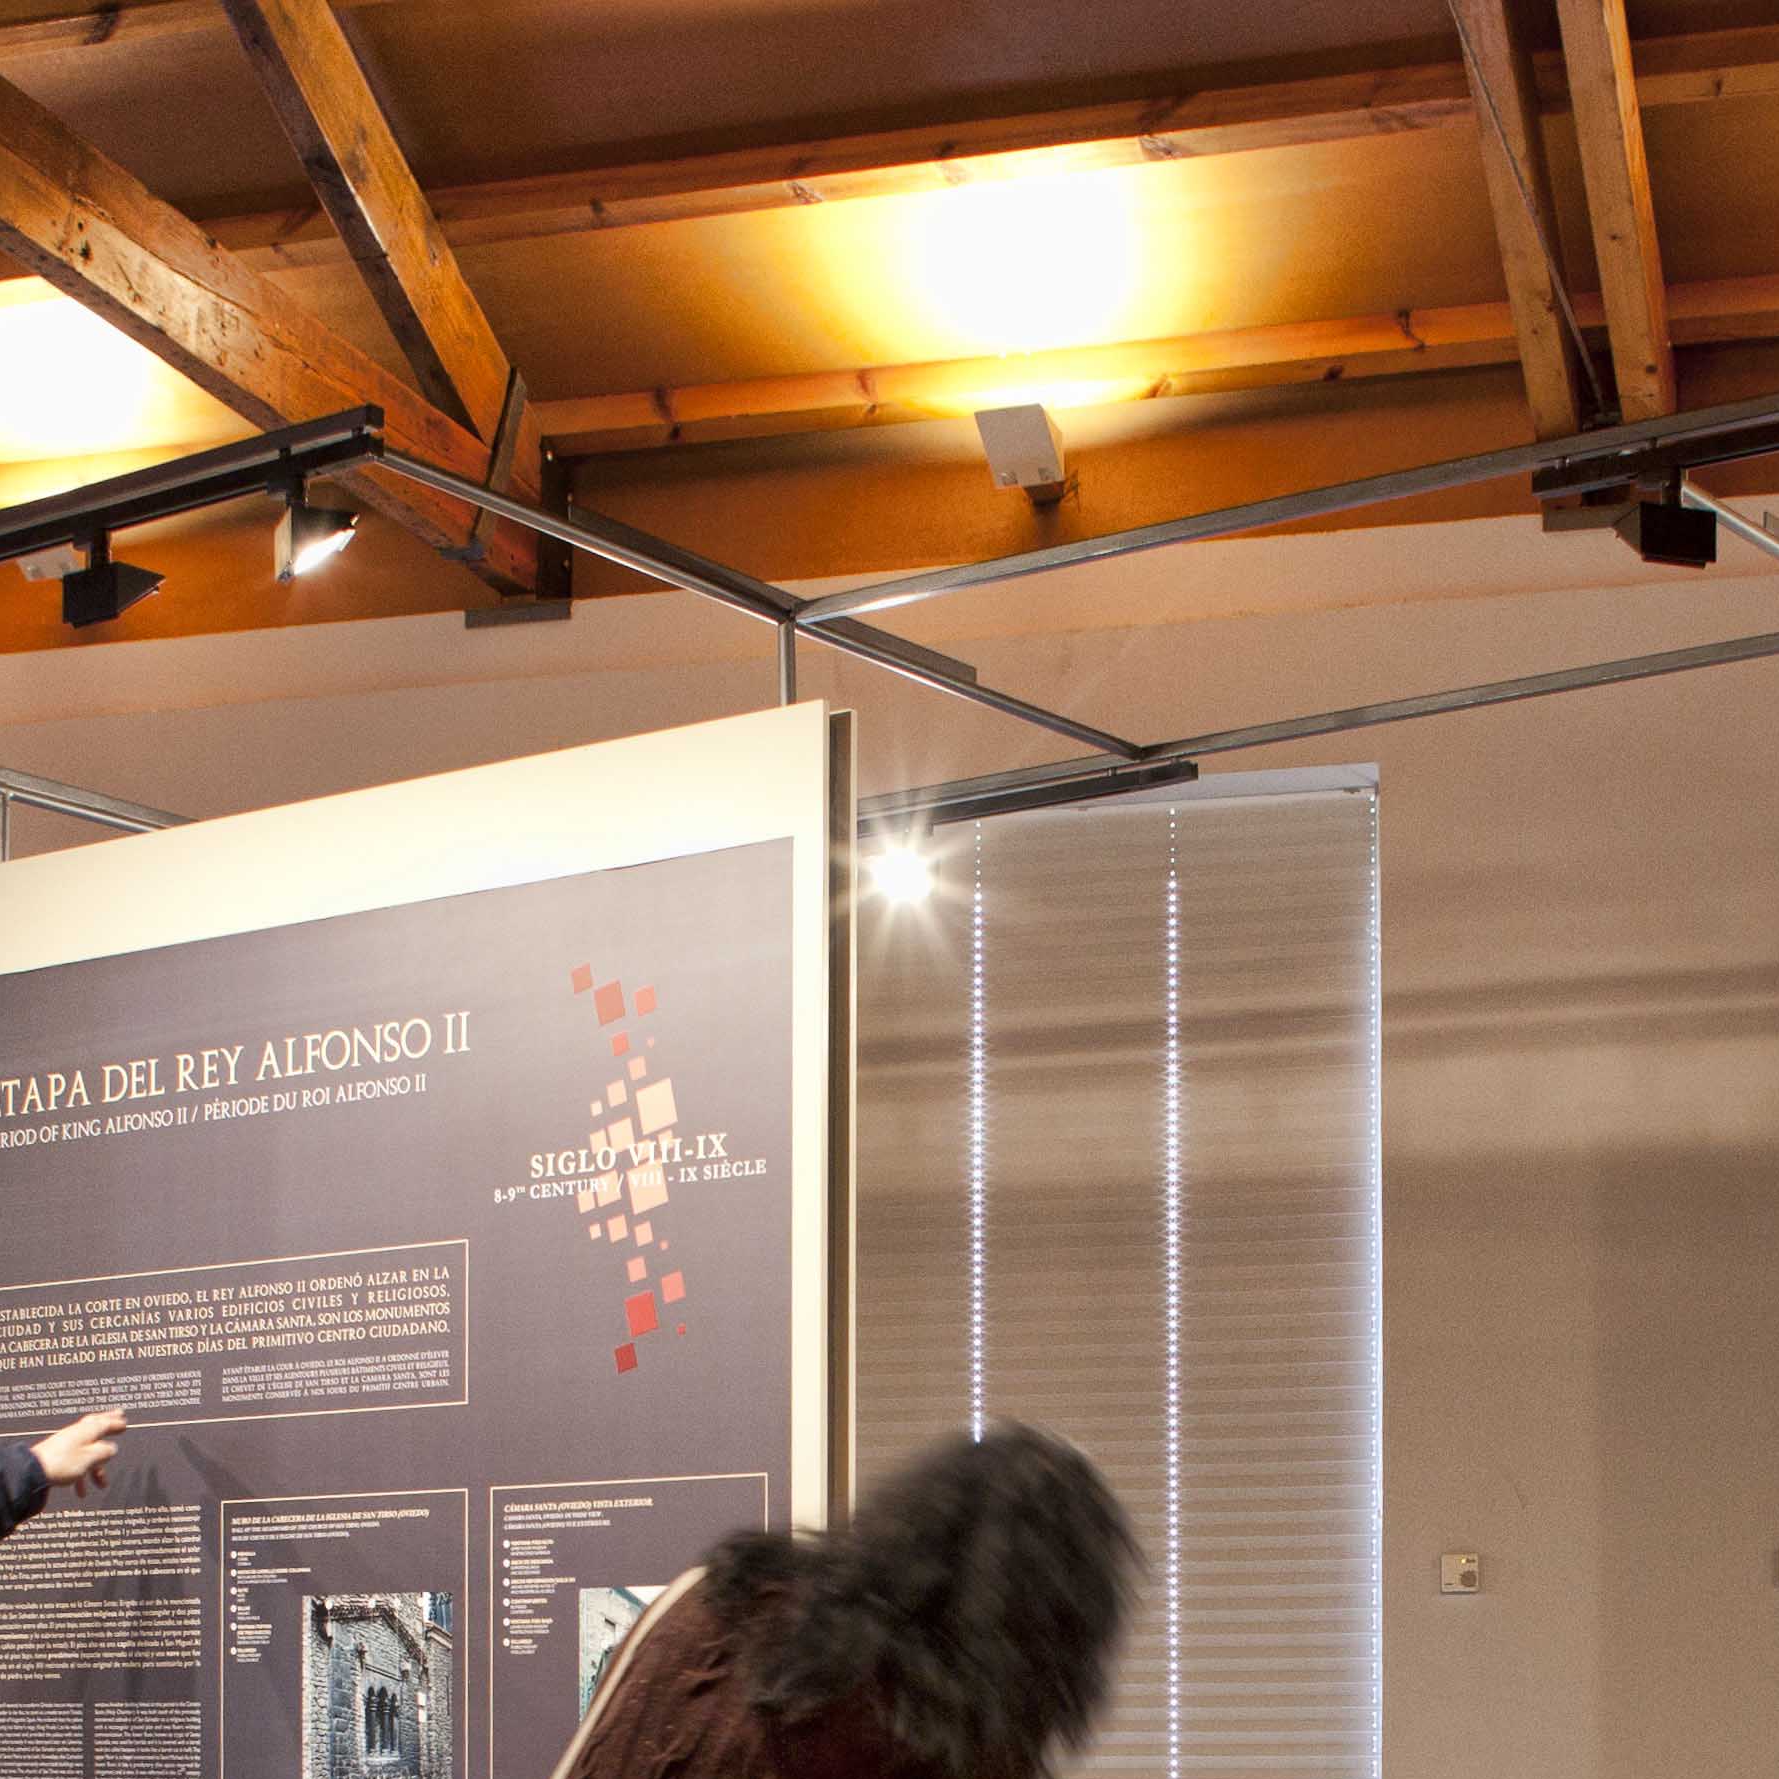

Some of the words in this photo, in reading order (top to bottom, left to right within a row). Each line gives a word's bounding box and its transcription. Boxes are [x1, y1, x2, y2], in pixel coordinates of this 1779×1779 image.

[103, 1061, 165, 1102] DEL
[176, 1047, 244, 1092] REY
[257, 1017, 432, 1081] ALFONSO
[443, 1011, 471, 1053] II
[40, 1126, 58, 1142] OF
[63, 1119, 100, 1140] KING
[106, 1110, 173, 1134] ALFONSO
[273, 1091, 297, 1112] DU
[302, 1087, 330, 1108] ROI
[335, 1078, 411, 1104] ALFONSO
[415, 1072, 430, 1092] II
[530, 1146, 616, 1178] SIGLO
[627, 1133, 728, 1167] VIII-IX
[530, 1177, 610, 1199] CENTURY
[630, 1169, 664, 1188] VIII
[680, 1166, 698, 1183] IX
[703, 1158, 767, 1181] SIÈCLE
[49, 1322, 54, 1332] Y
[63, 1319, 83, 1331] SUS
[91, 1311, 160, 1329] CERCANÍAS
[169, 1306, 214, 1321] VARIOS
[222, 1300, 284, 1319] EDIFICIOS
[292, 1294, 342, 1310] CIVILES
[352, 1292, 358, 1305] Y
[69, 1303, 81, 1316] LA
[86, 1299, 121, 1314] CORTE
[126, 1297, 140, 1311] EN
[197, 1290, 209, 1303] EL
[213, 1287, 234, 1301] REY
[239, 1282, 293, 1298] ALFONSO
[310, 1272, 362, 1291] ORDENÓ
[367, 1271, 407, 1286] ALZAR
[413, 1267, 429, 1282] EN
[434, 1266, 450, 1281] LA
